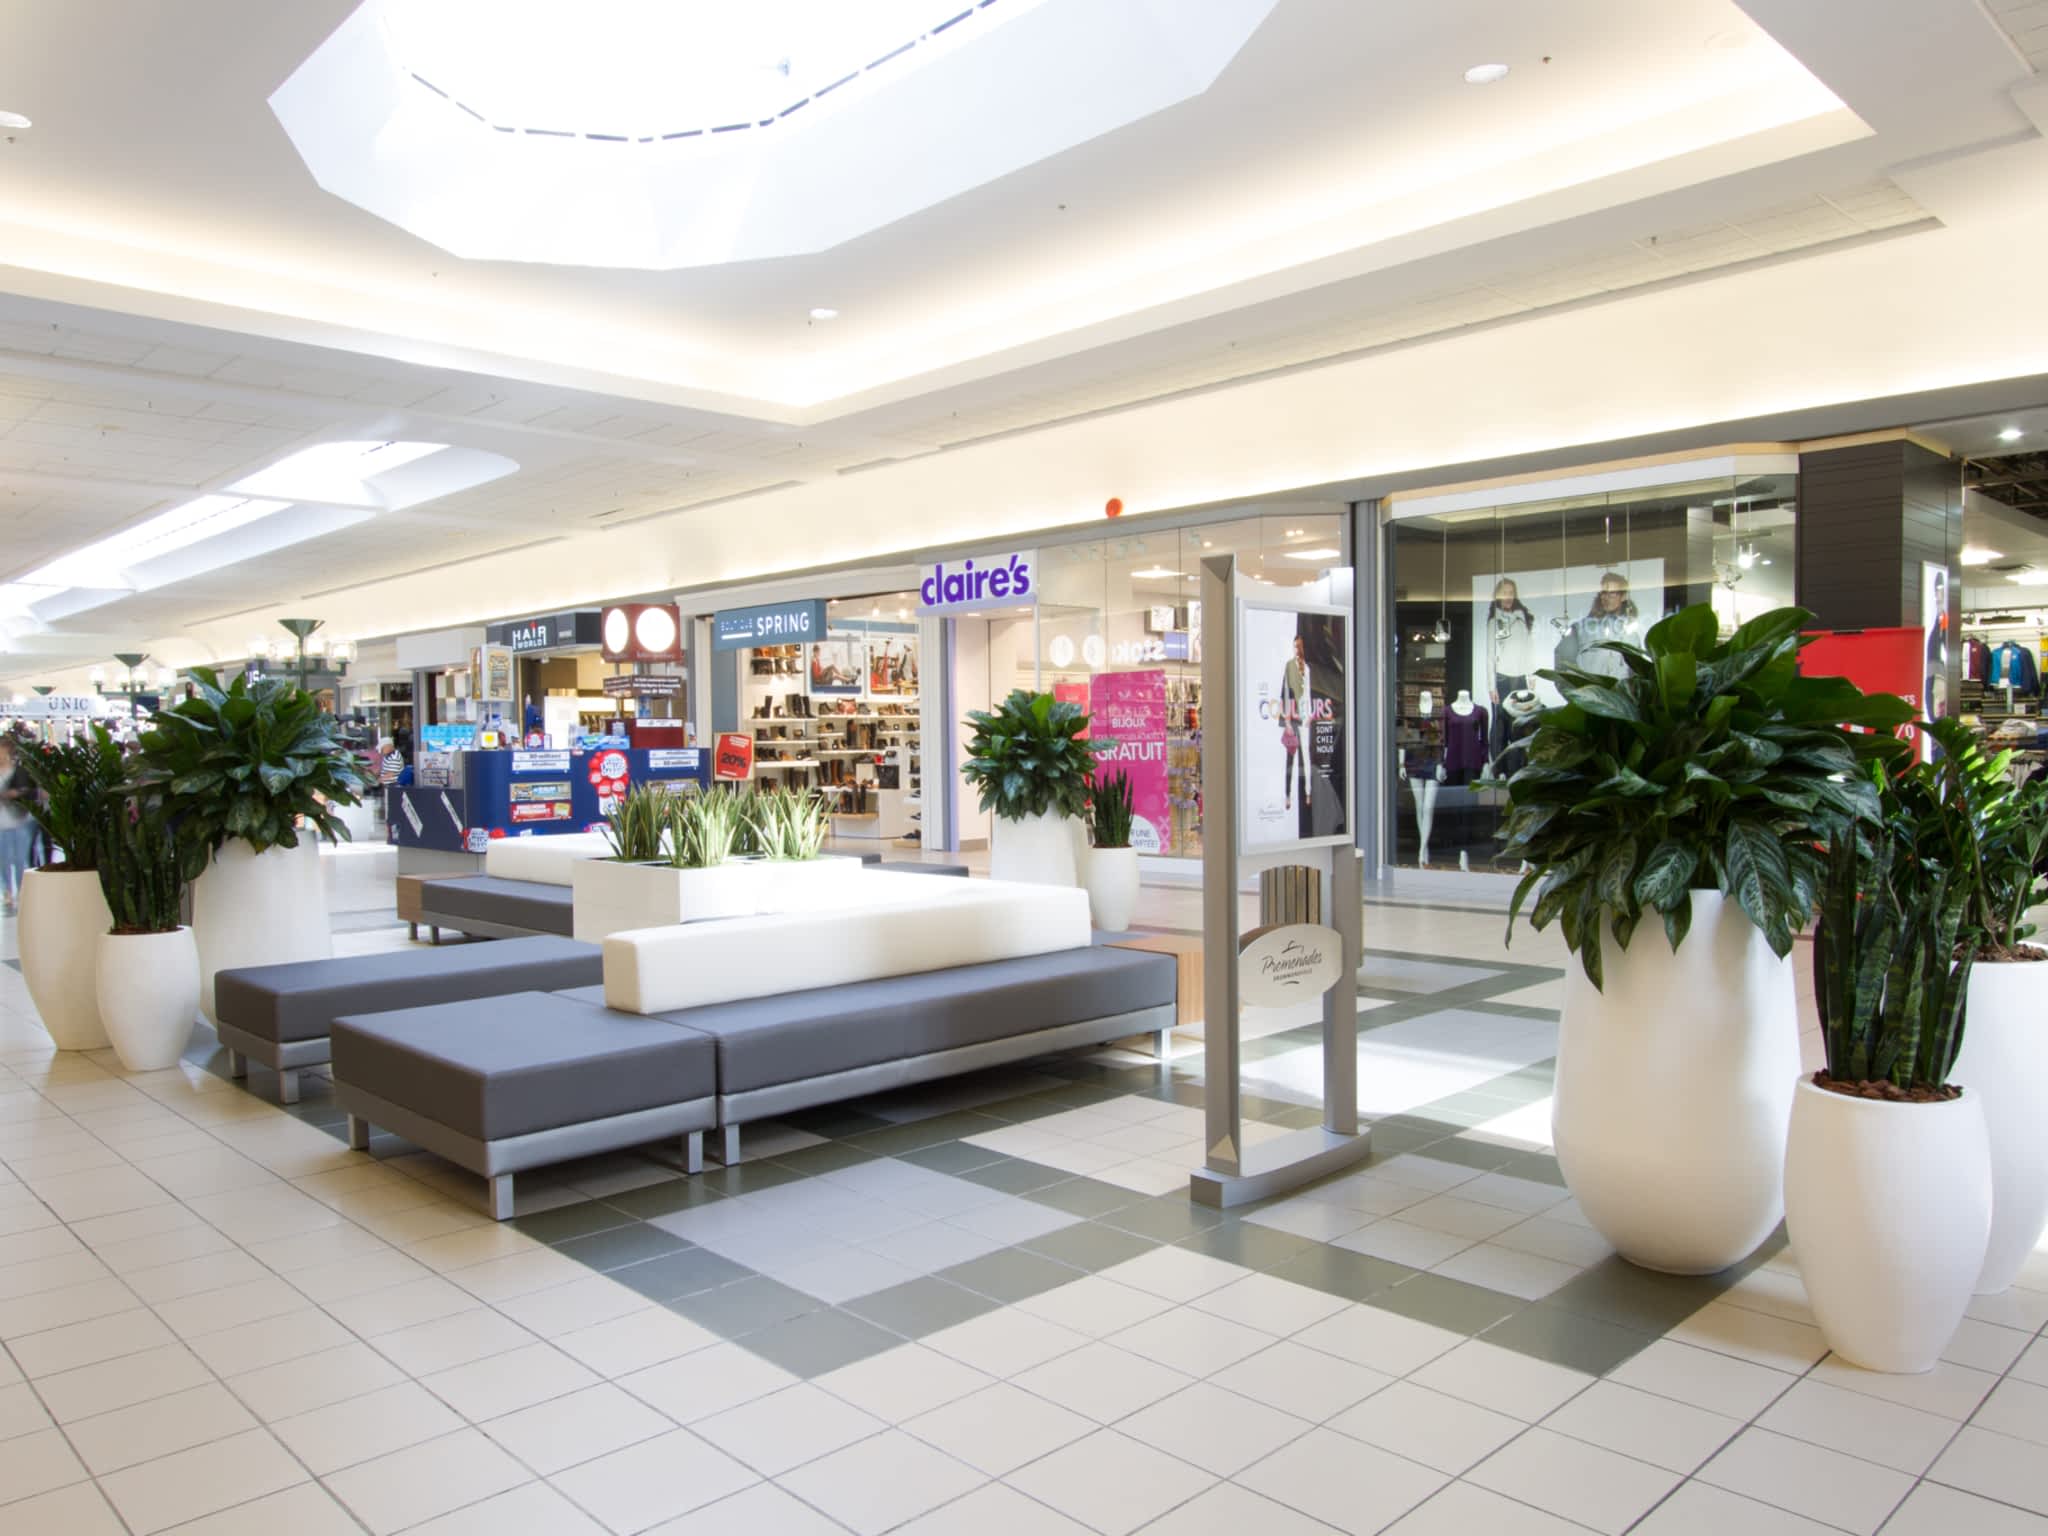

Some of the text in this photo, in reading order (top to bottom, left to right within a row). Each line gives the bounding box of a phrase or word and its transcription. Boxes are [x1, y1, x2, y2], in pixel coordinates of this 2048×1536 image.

[921, 554, 1030, 606] claire's
[757, 611, 809, 636] SPRING
[512, 625, 547, 650] HAIR
[1259, 698, 1334, 721] COULEURS
[1112, 718, 1146, 728] BIJOUX
[1316, 726, 1333, 734] SONT
[1316, 736, 1333, 744] CHEZ
[1317, 745, 1334, 753] NOUS
[1095, 742, 1164, 760] GRATUIT
